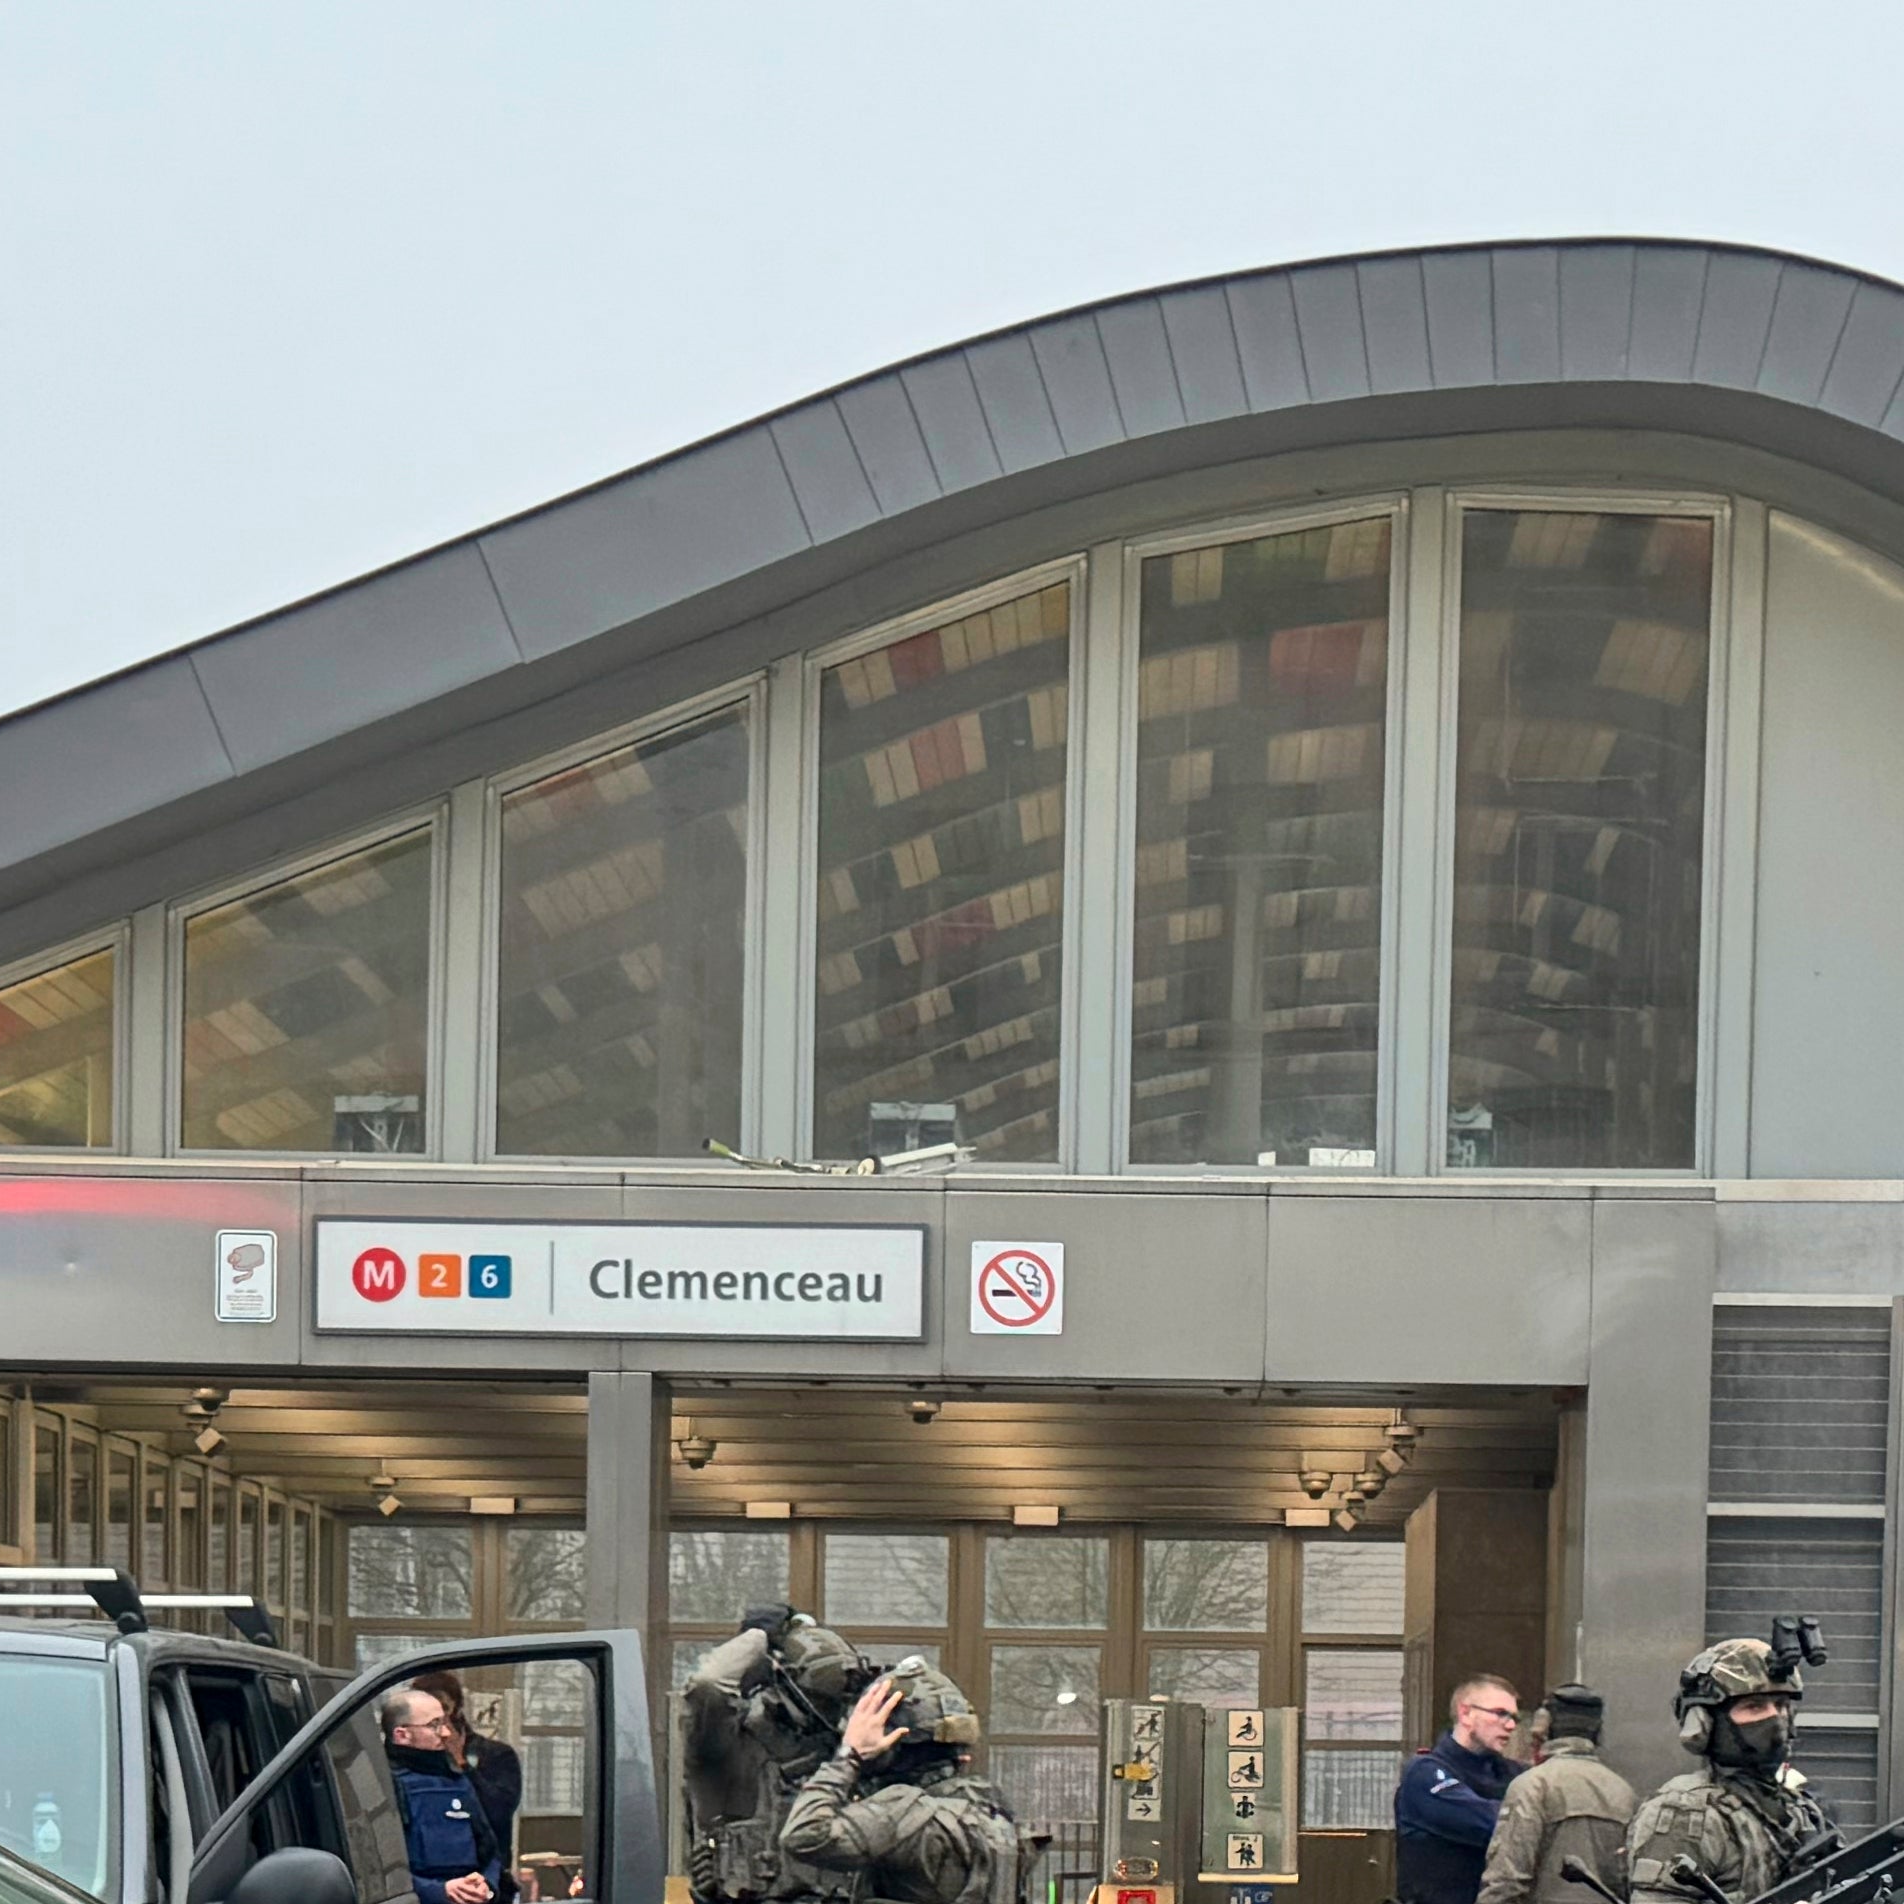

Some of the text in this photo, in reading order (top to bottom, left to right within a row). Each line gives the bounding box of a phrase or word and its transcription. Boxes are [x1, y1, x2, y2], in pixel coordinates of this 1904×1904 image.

[362, 1258, 883, 1303] M 2 6 Clemenceau
